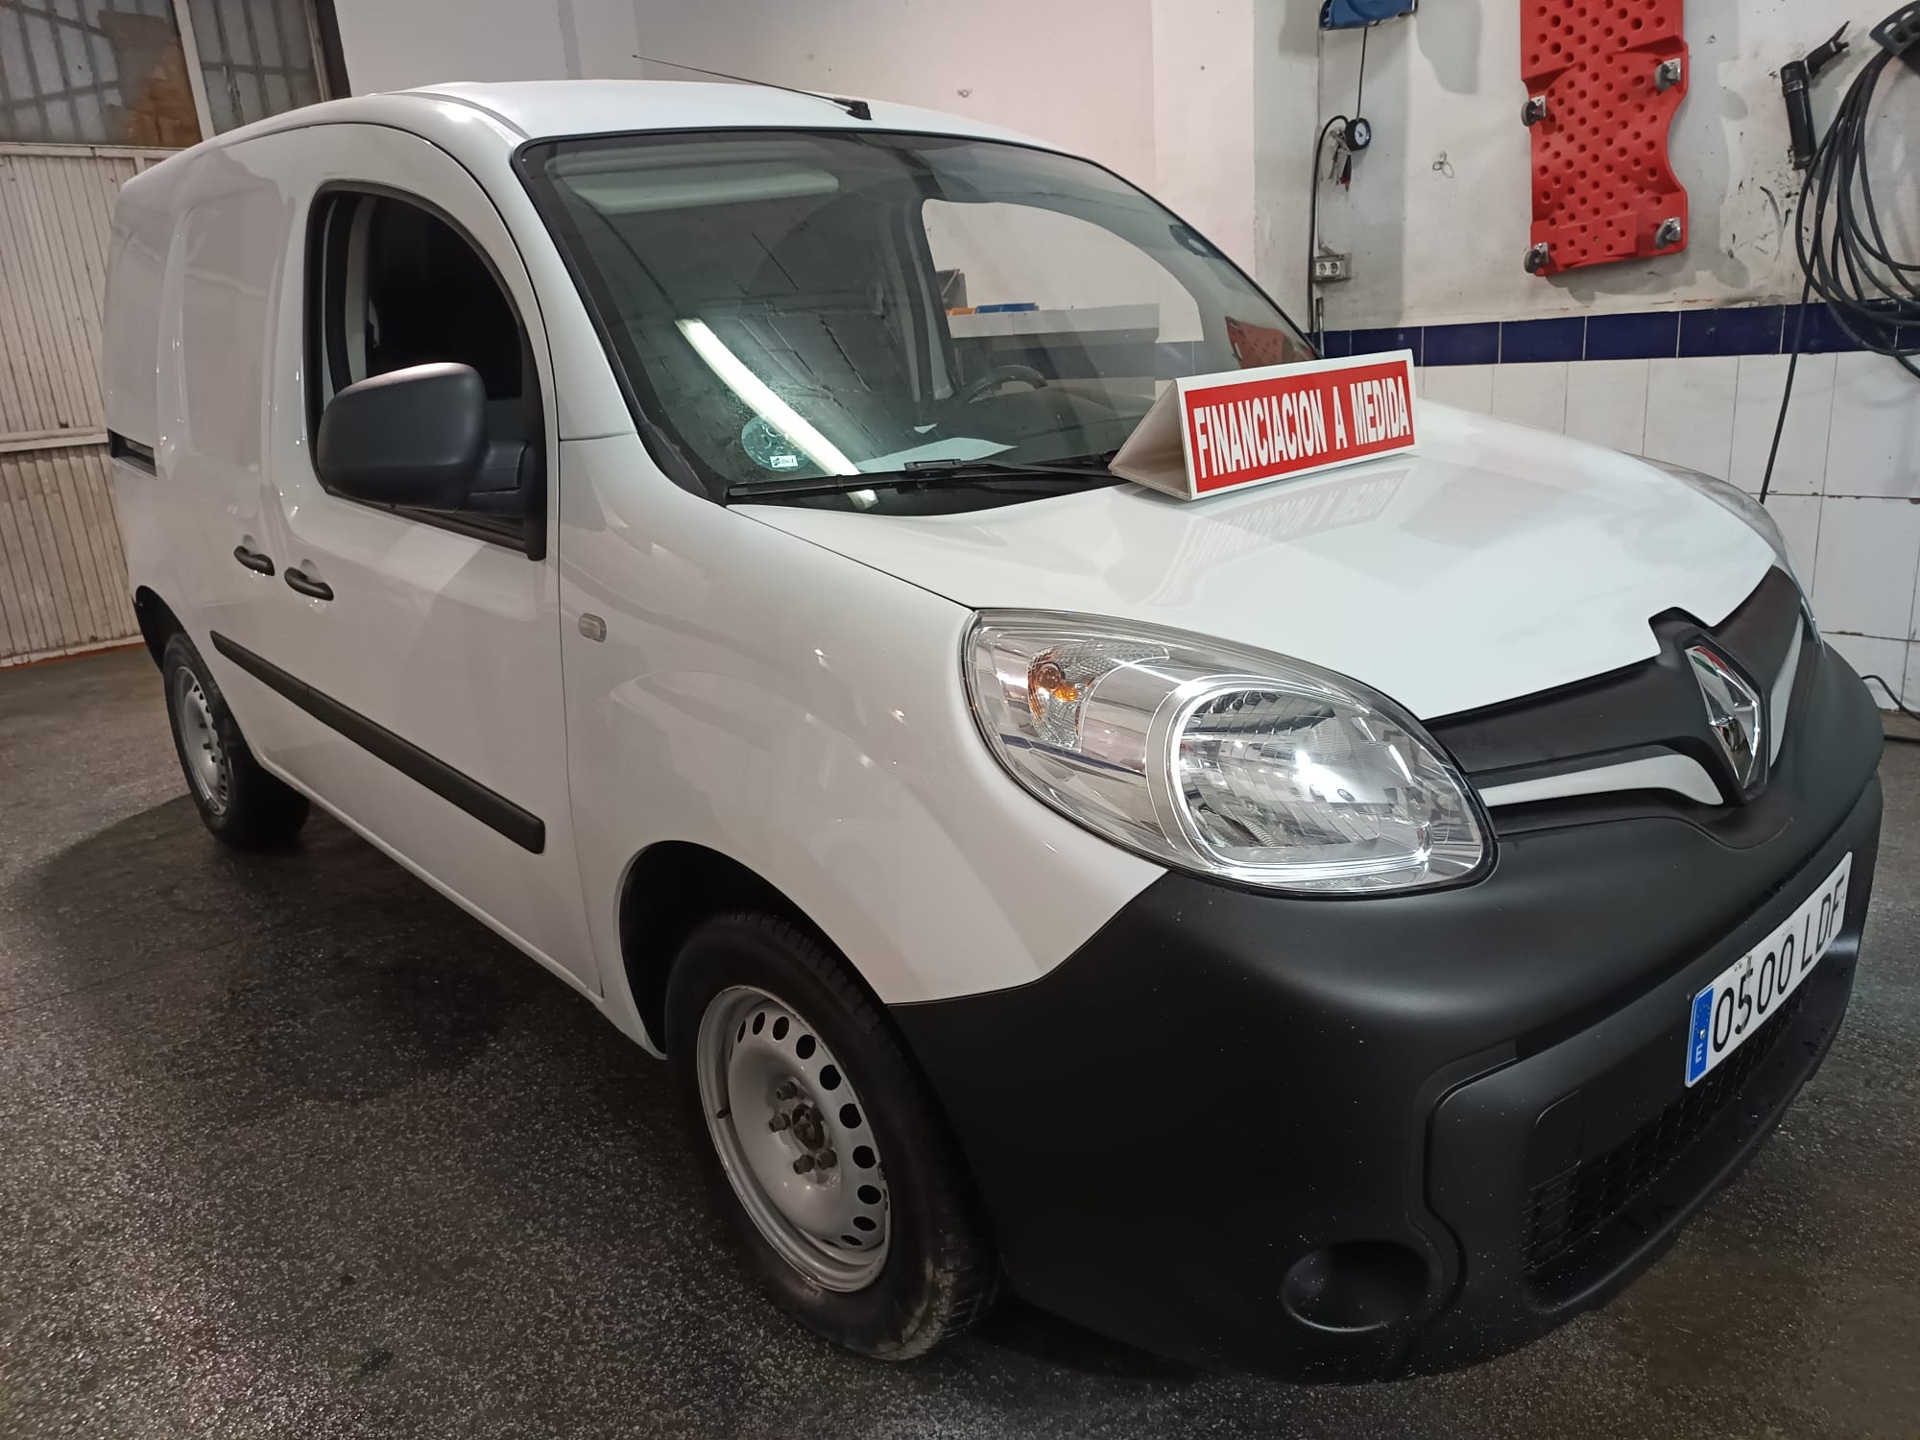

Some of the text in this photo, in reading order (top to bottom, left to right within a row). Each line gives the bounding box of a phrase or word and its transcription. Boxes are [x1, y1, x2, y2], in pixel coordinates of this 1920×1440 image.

[1193, 376, 1411, 478] FINANCIACION A MEDIDA
[1713, 873, 1845, 1053] 0500 LDF
[1695, 1045, 1704, 1063] E
